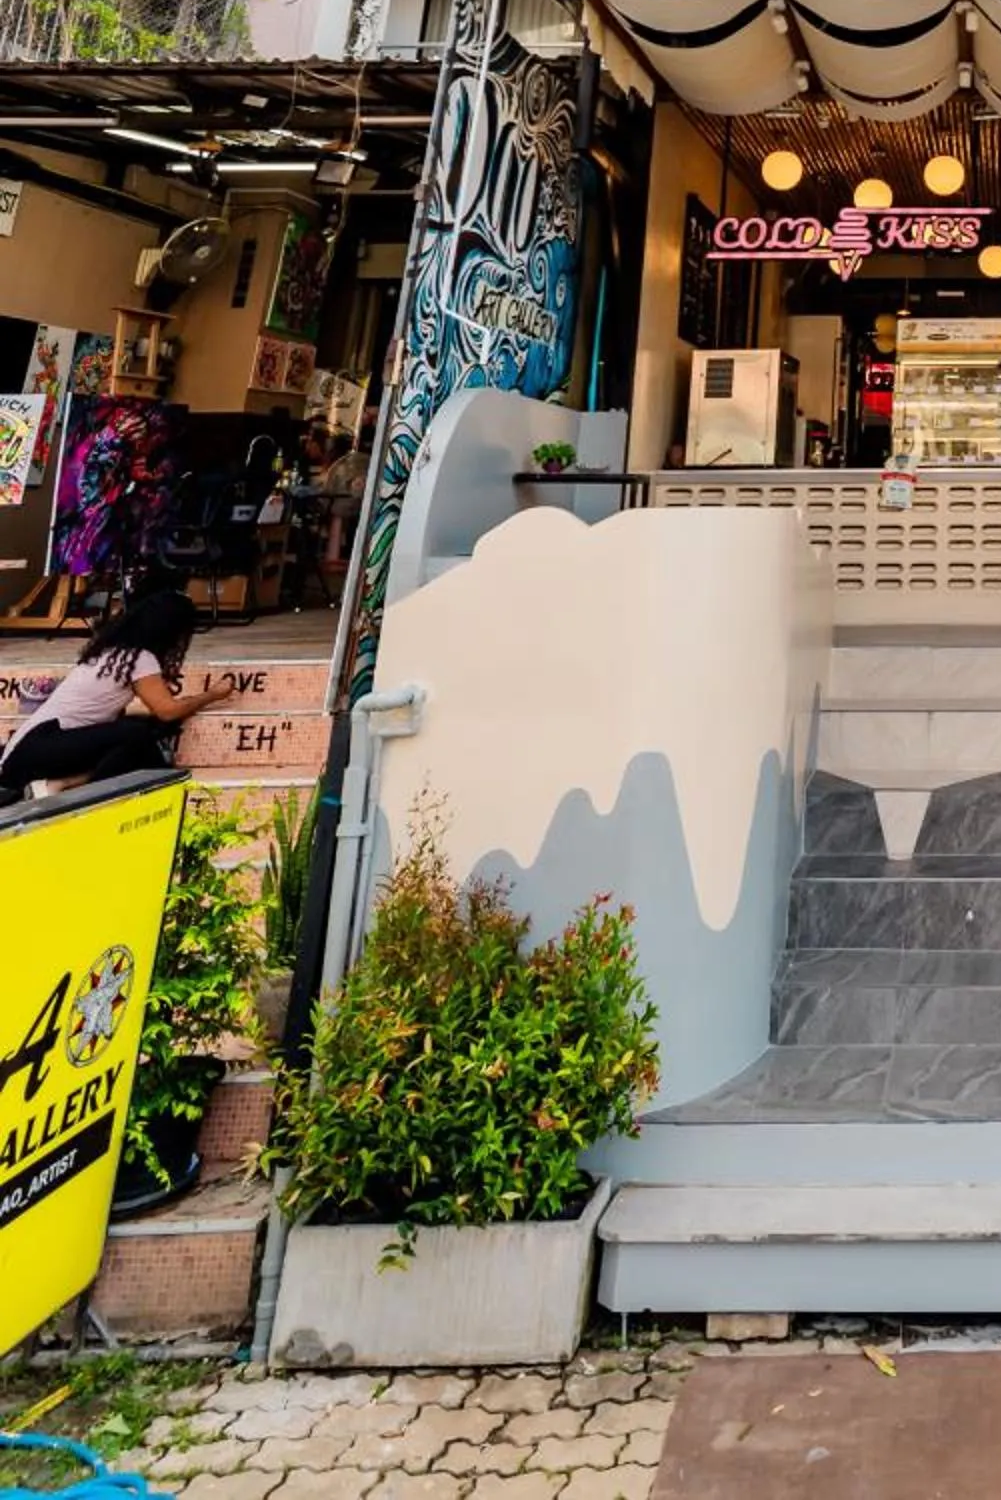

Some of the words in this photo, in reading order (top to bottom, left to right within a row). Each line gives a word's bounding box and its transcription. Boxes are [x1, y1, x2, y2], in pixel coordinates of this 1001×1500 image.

[713, 216, 824, 249] COLD
[877, 216, 982, 249] KISS
[473, 284, 506, 327] ART
